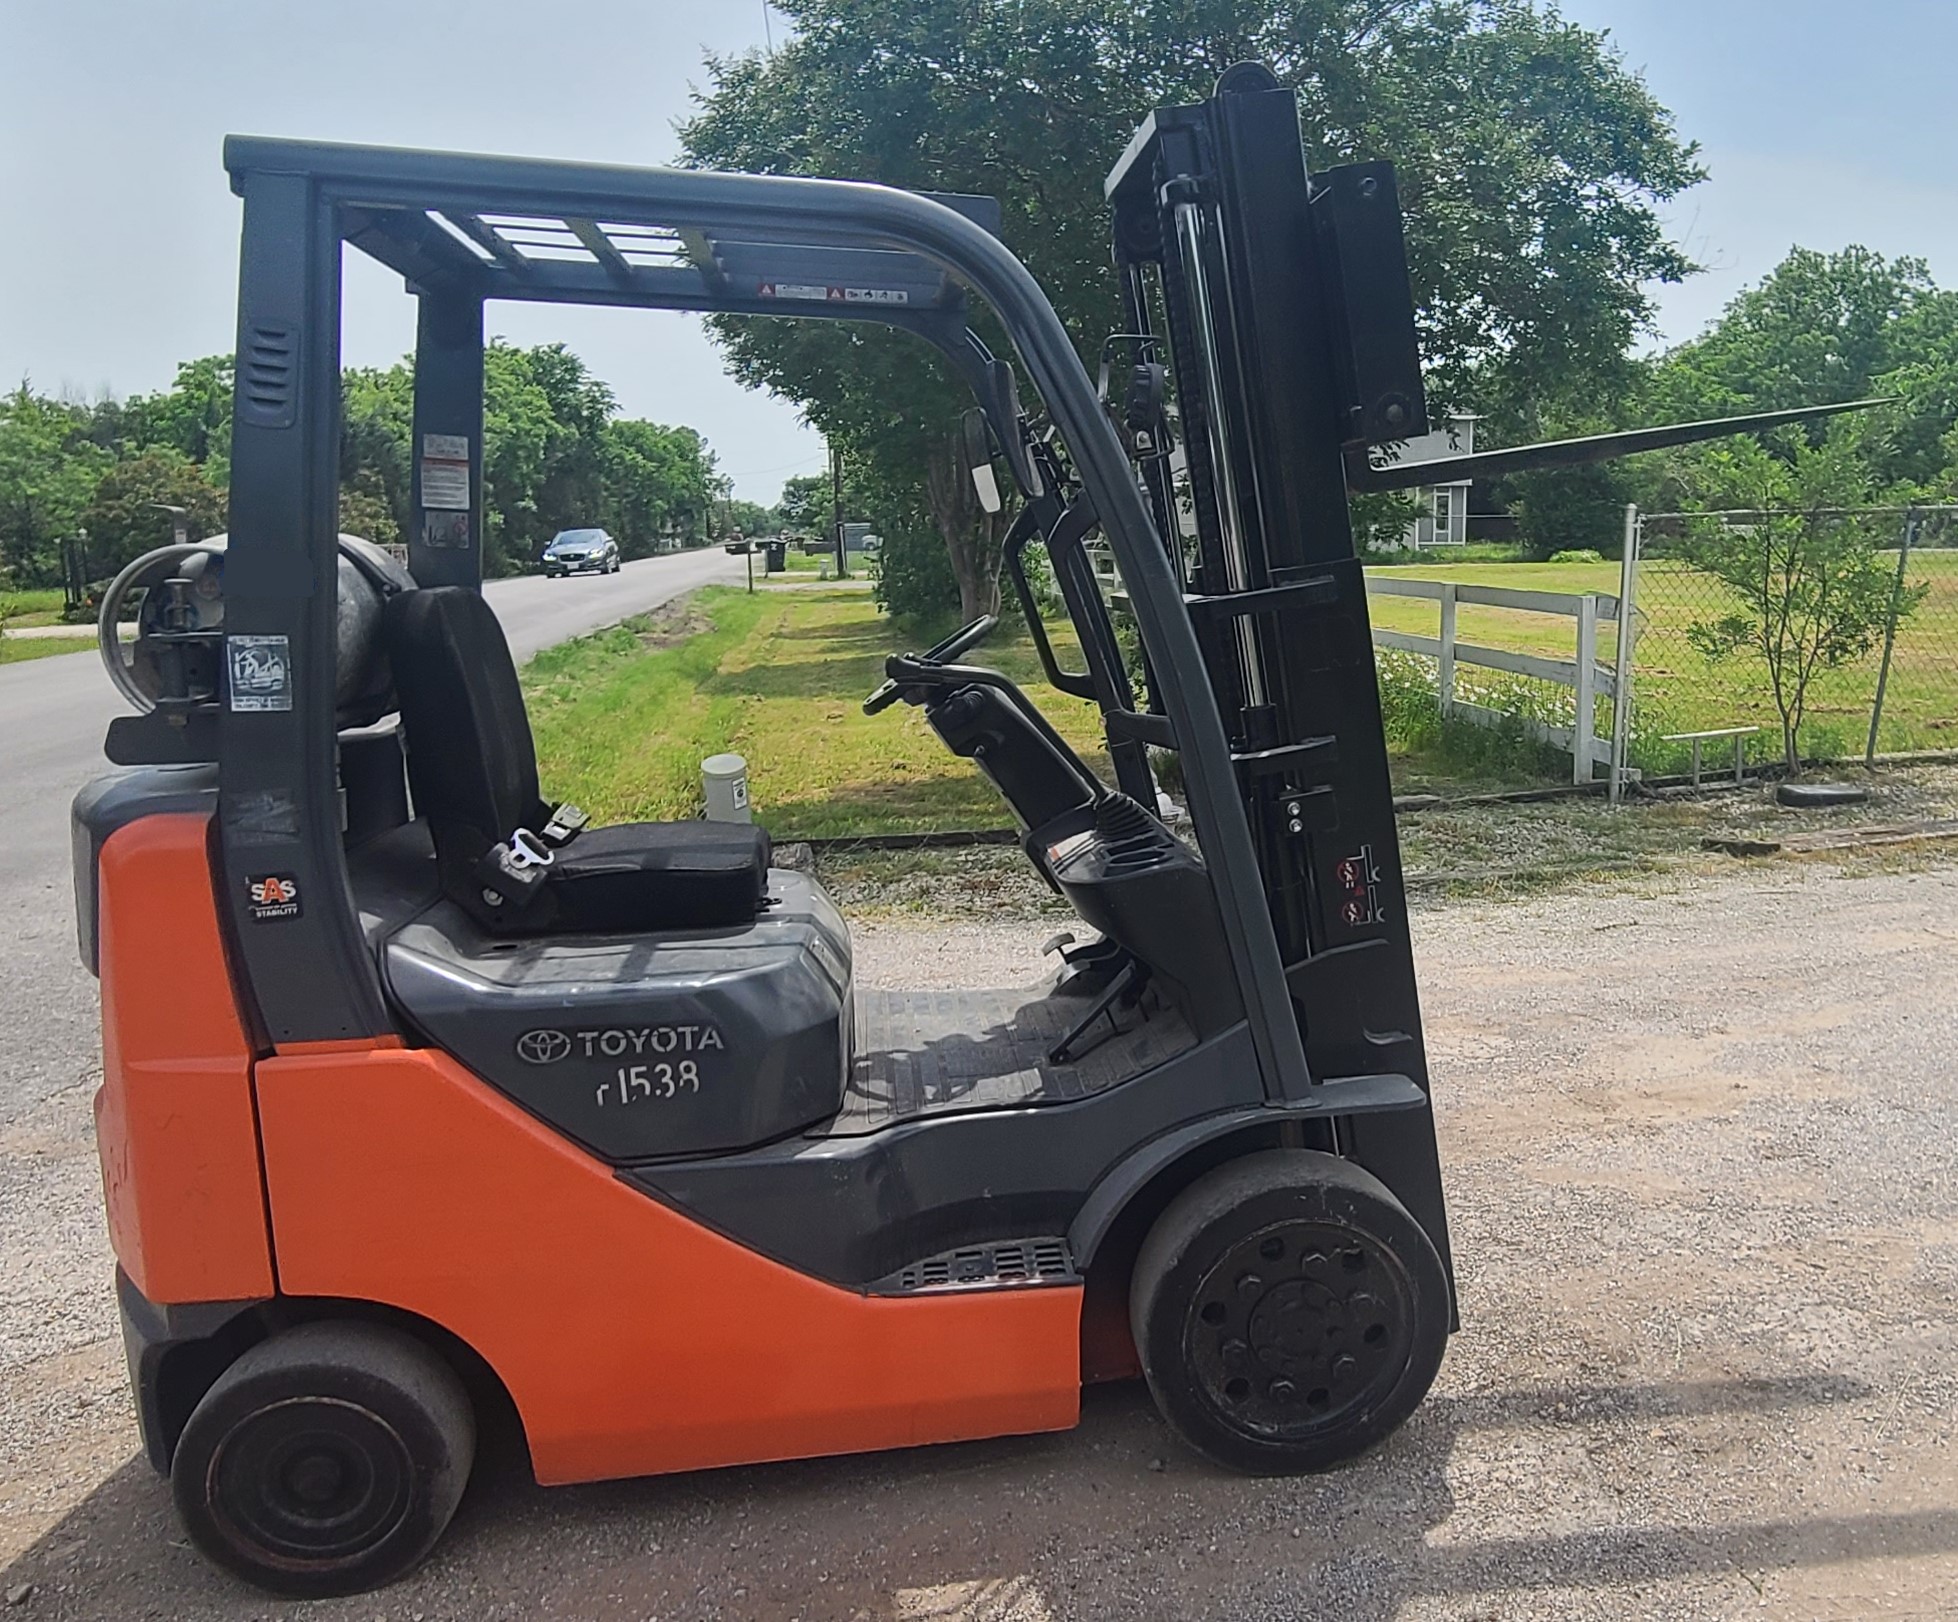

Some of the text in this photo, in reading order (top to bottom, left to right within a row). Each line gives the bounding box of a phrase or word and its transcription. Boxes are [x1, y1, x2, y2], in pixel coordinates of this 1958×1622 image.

[251, 877, 297, 904] SAS
[256, 906, 298, 918] STABILITY
[577, 1026, 725, 1057] TOYOTA
